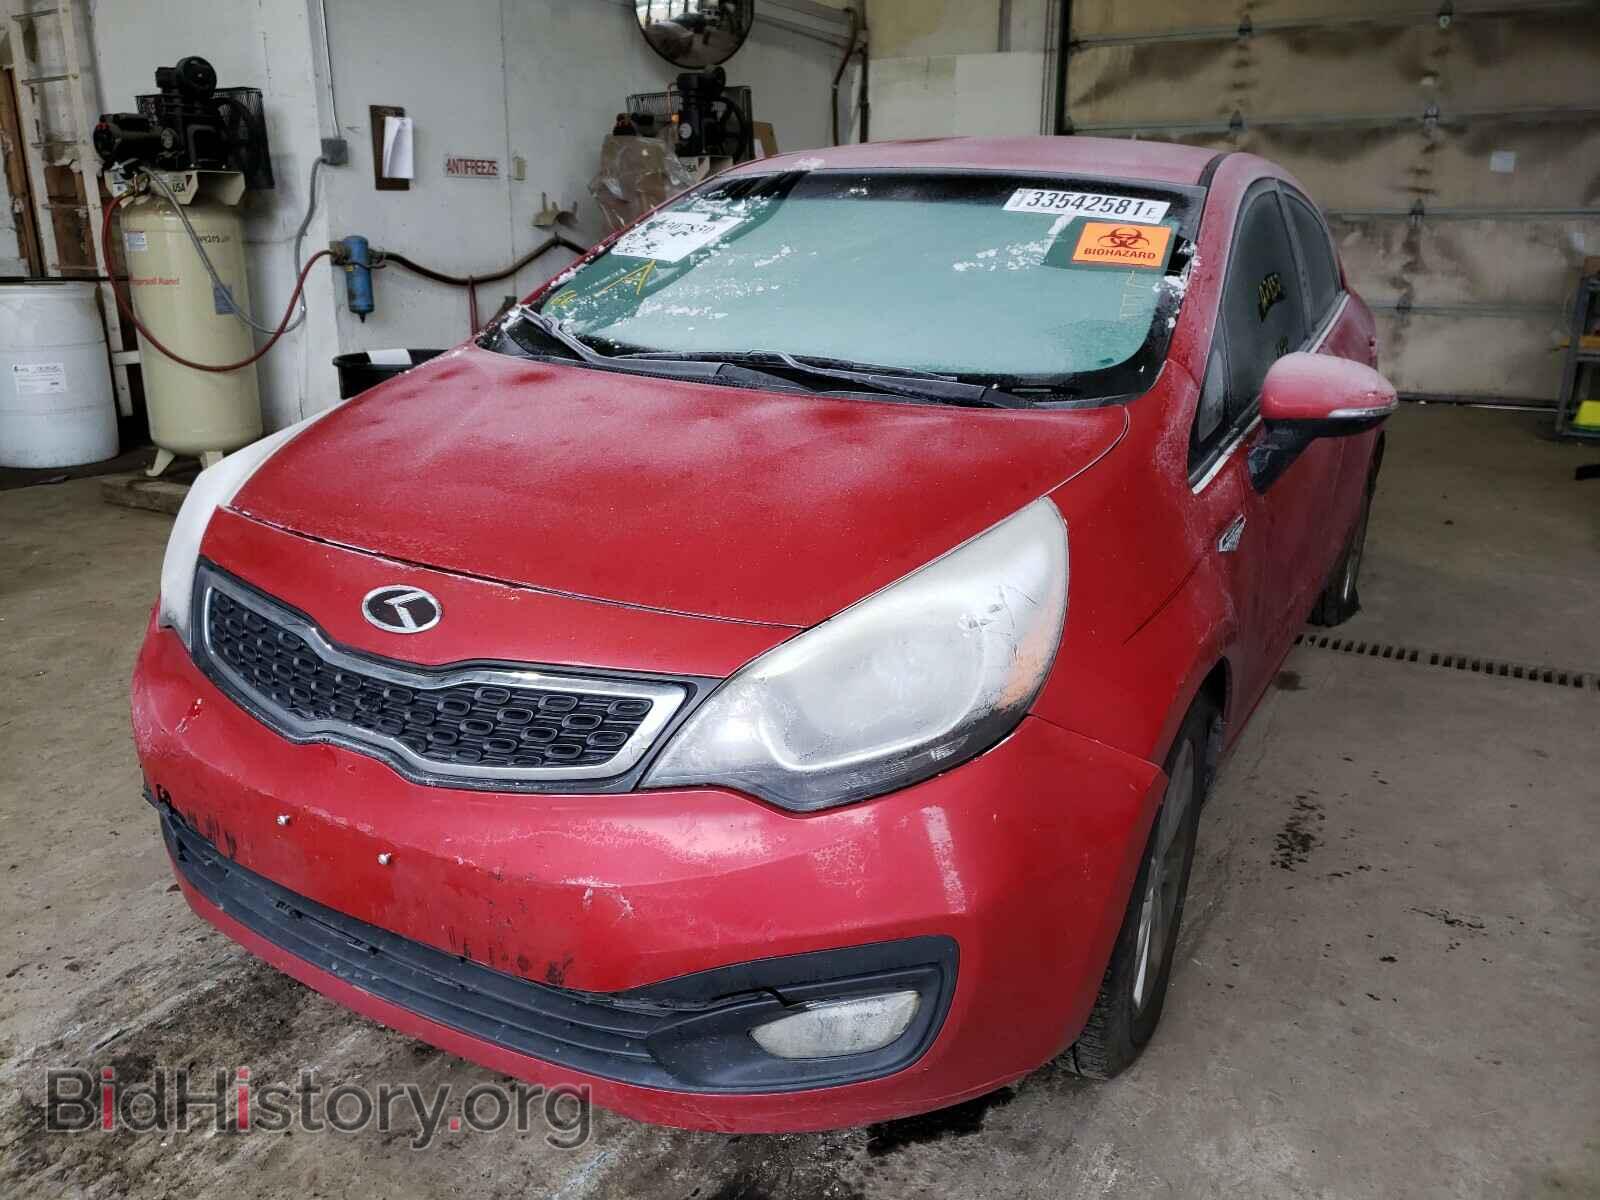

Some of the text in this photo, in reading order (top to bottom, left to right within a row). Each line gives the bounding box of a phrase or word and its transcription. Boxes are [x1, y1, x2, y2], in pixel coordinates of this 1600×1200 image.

[447, 158, 497, 176] ANTIFREEZE
[1026, 191, 1146, 217] 33542581
[1083, 247, 1157, 260] BIOHAZARD
